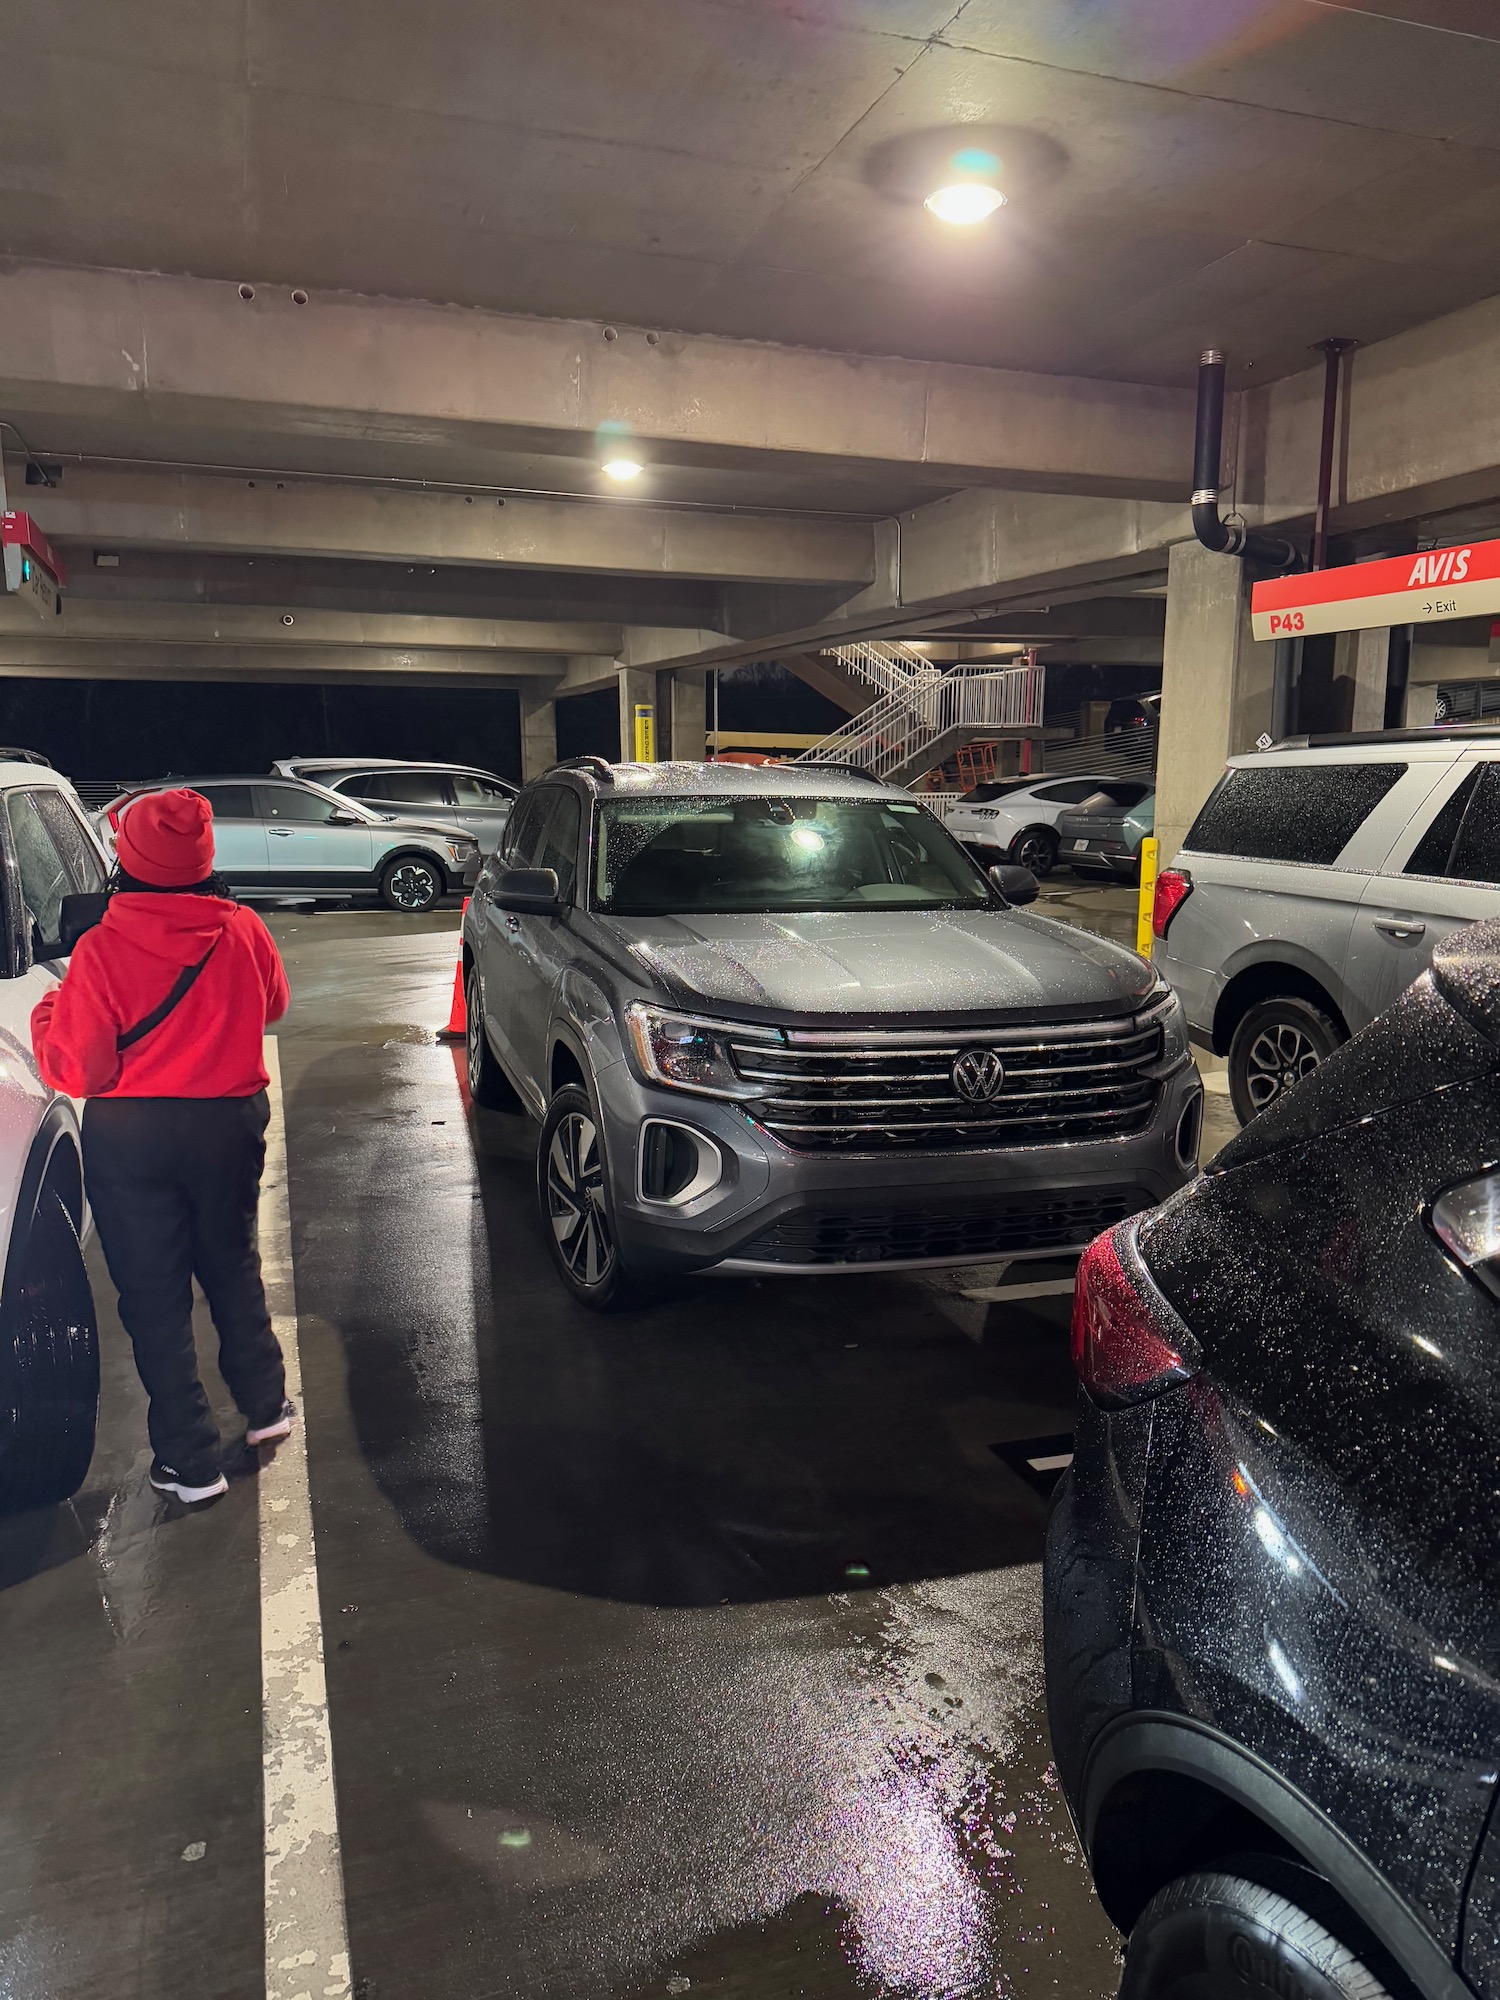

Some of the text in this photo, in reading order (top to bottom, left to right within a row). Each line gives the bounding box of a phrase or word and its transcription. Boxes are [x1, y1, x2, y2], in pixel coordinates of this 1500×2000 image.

[1407, 549, 1471, 587] AVIS
[1435, 600, 1457, 614] Exit
[1270, 612, 1305, 634] P43
